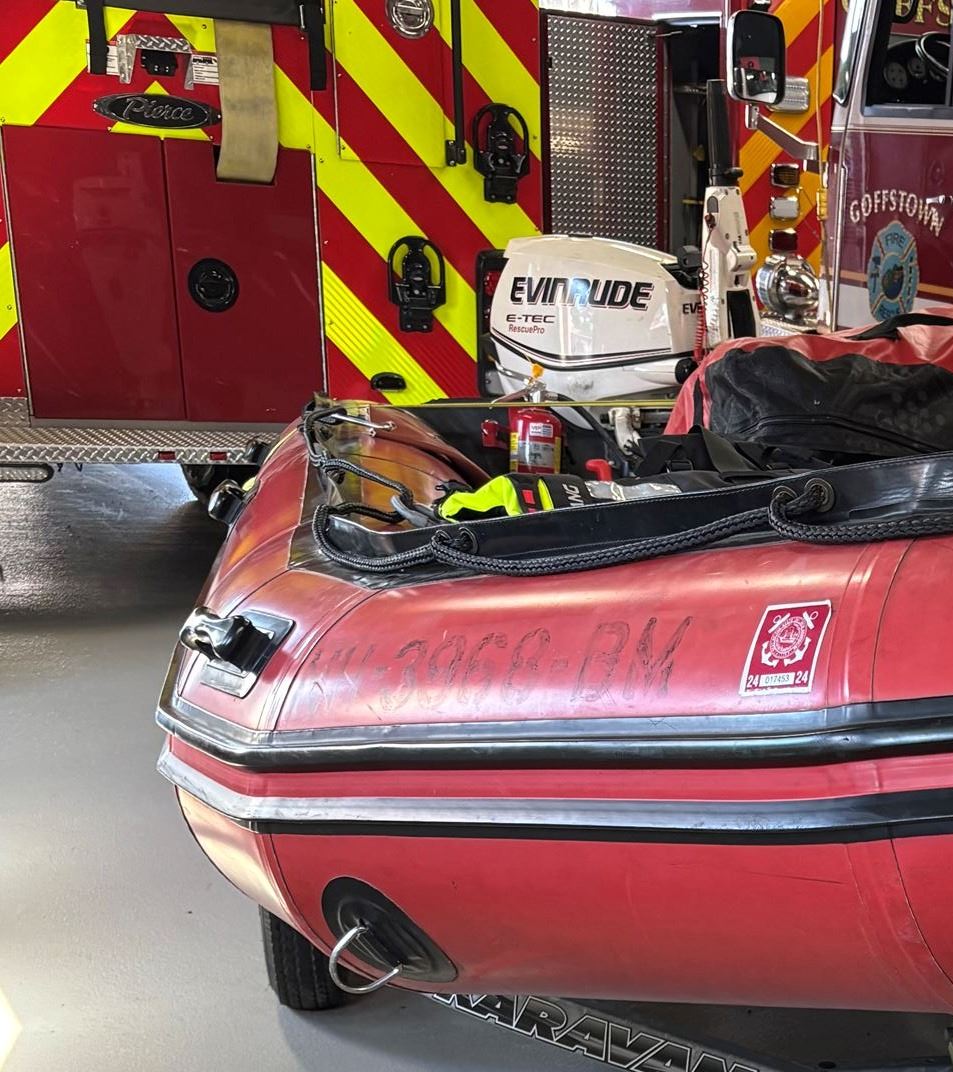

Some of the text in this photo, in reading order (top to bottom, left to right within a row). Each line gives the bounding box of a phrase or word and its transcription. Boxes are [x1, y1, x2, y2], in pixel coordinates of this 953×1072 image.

[122, 95, 194, 121] Pierce
[850, 189, 945, 237] GOFFSTOWN
[510, 276, 655, 312] EVINRUDE
[505, 313, 557, 324] E-TEC
[508, 323, 545, 335] RescuePro
[746, 674, 759, 688] 24
[795, 670, 809, 684] 24
